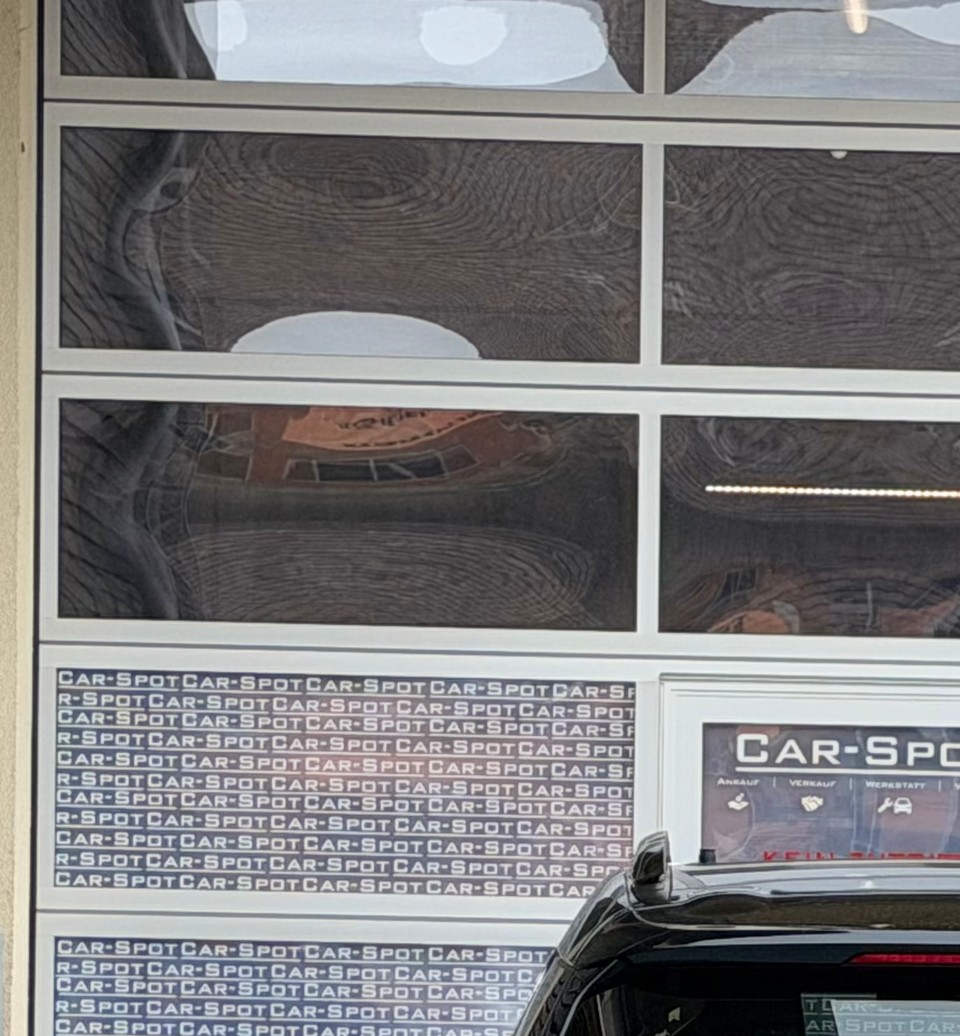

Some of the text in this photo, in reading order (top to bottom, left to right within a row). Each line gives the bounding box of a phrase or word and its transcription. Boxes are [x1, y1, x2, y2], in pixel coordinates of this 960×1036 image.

[58, 672, 179, 687] CAR-SPOT
[182, 675, 303, 690] CAR-SPOT
[306, 678, 426, 693] CAR-SPOT
[429, 681, 549, 696] CAR-SPOT
[148, 694, 269, 710] CAR-SPOT
[272, 697, 392, 713] CAR-SPOT
[396, 700, 515, 715] CAR-SPOT
[58, 710, 549, 734] CAR-SPOT CAR-SPOT CAR-SPOT CAR-SPOT
[148, 733, 268, 748] CAR-SPOT
[271, 736, 392, 751] CAR-SPOT
[395, 739, 515, 754] CAR-SPOT
[57, 751, 178, 767] CAR-SPOT
[181, 754, 302, 770] CAR-SPOT
[304, 757, 425, 773] CAR-SPOT
[428, 759, 548, 775] CAR-SPOT
[147, 774, 268, 789] CAR-SPOT
[271, 776, 391, 792] CAR-SPOT
[395, 779, 514, 794] CAR-SPOT
[57, 790, 547, 813] CAR-SPOT CAR-SPOT CAR-SPOT CAR-SPOT
[146, 813, 267, 828] CAR-SPOT
[270, 815, 390, 831] CAR-SPOT
[394, 818, 513, 833] CAR-SPOT
[56, 832, 176, 847] CAR-SPOT
[180, 834, 300, 849] CAR-SPOT
[303, 837, 423, 852] CAR-SPOT
[427, 840, 547, 855] CAR-SPOT
[146, 854, 513, 874] CAR-SPOT CAR-SPOT CAR-SPOT
[55, 873, 546, 895] CAR-SPOT CAR-SPOT CAR-SPOT CAR-SPOT
[57, 940, 548, 962] CAR-SPOT CAR-SPOT CAR-SPOT CAR-SPOT
[147, 962, 513, 982] CAR-SPOT CAR-SPOT CAR-SPOT
[57, 978, 532, 1001] CAR-SPOT CAR-SPOT CAR-SPOT CAR-SPO
[146, 1001, 513, 1021] CAR-SPOT CAR-SPOT CAR-SPOT
[56, 1020, 176, 1034] CAR-SPOT
[179, 1022, 299, 1036] CAR-SPOT
